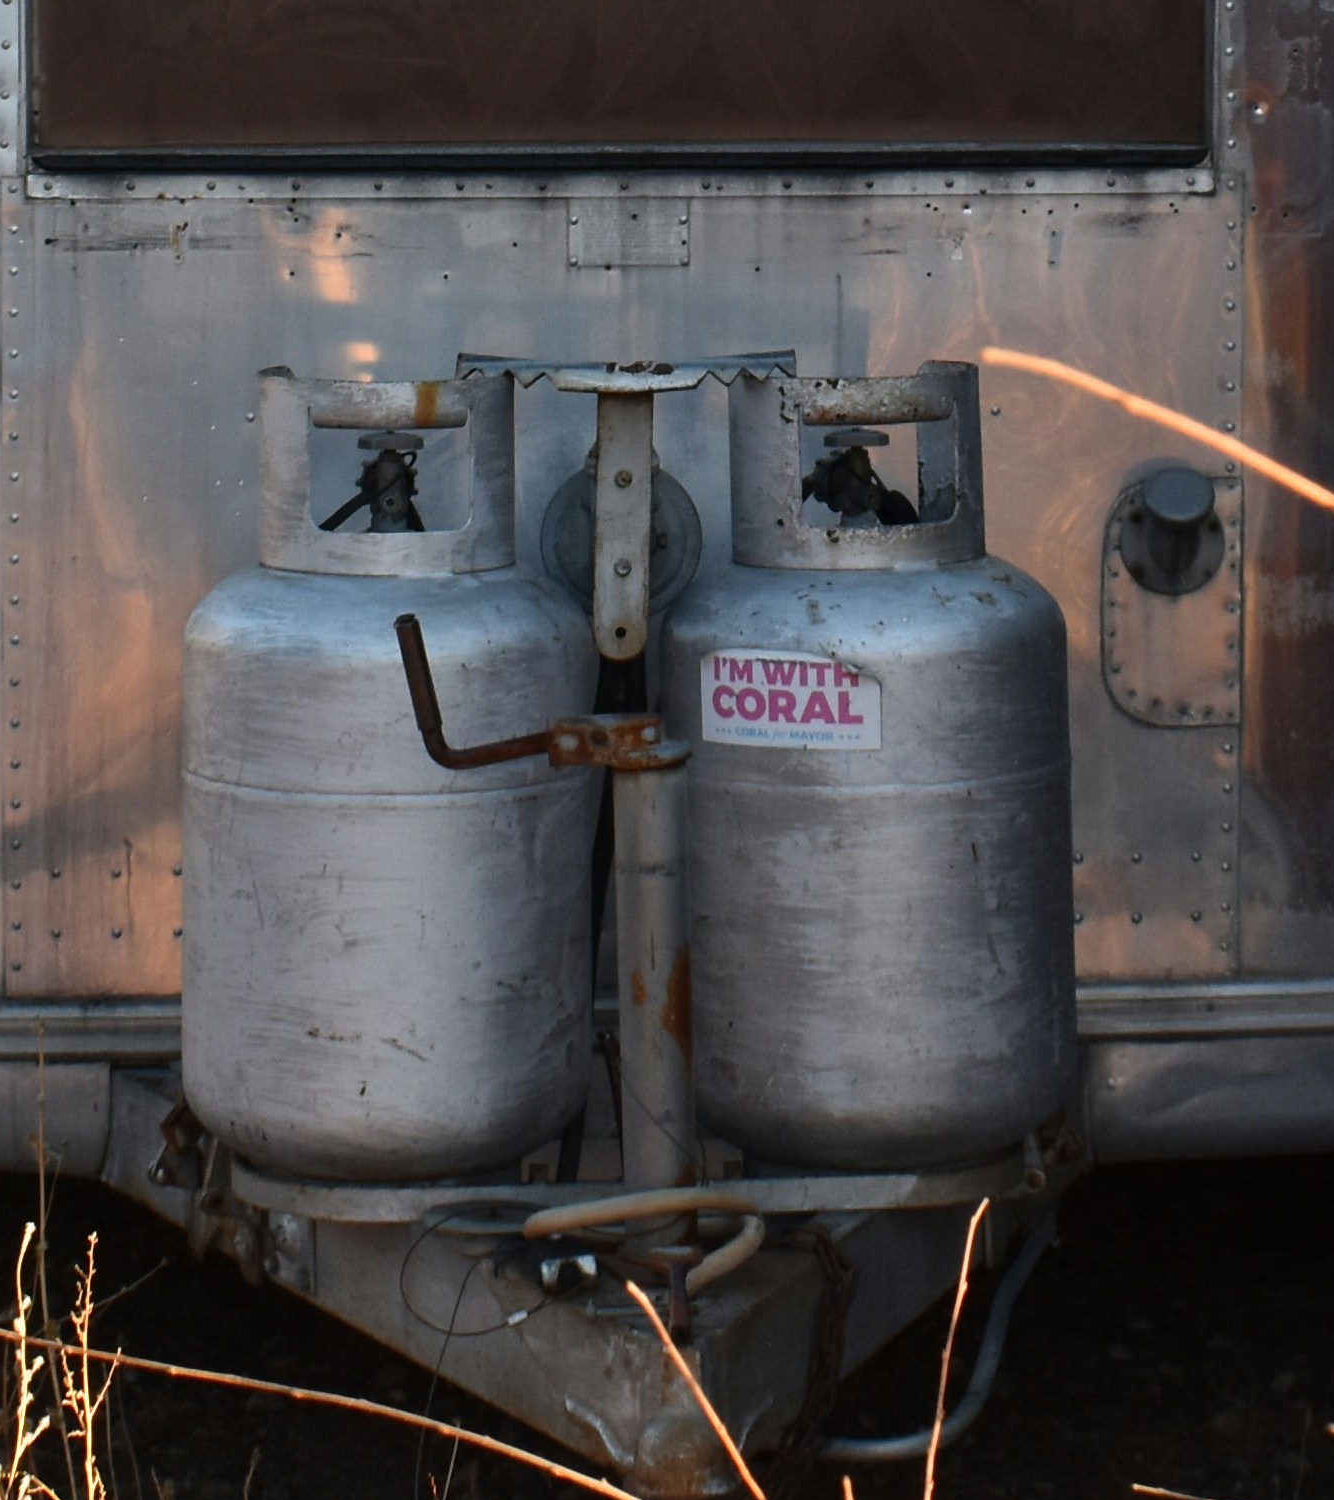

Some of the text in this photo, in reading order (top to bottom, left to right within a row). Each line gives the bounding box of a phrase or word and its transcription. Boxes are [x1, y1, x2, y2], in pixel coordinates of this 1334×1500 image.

[713, 655, 860, 687] I'M WITH
[712, 684, 864, 724] CORAL
[735, 727, 769, 738] CORAL
[790, 730, 834, 741] MAYOR
